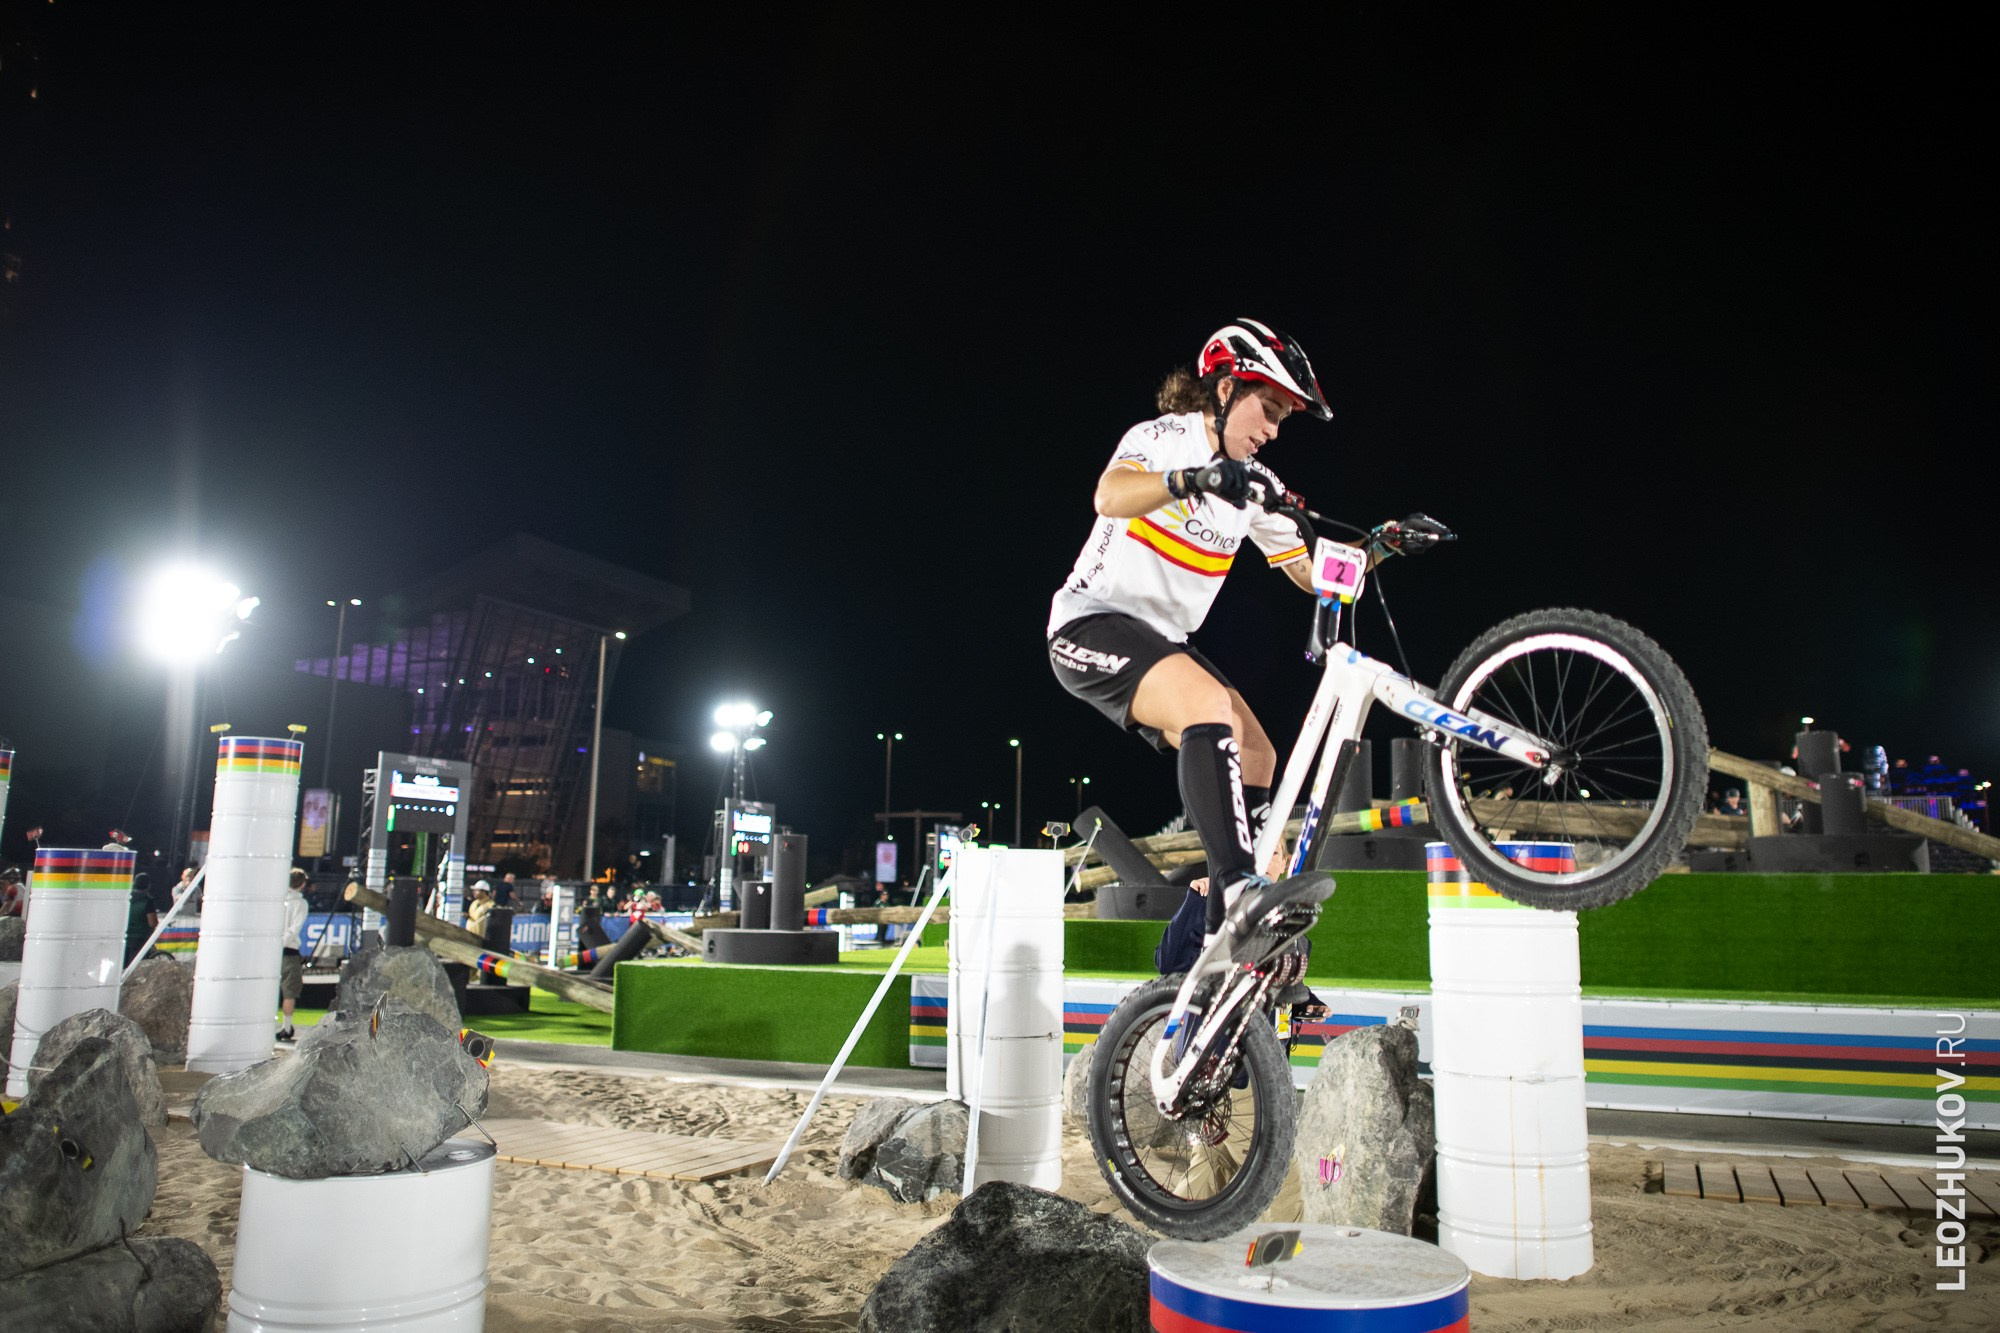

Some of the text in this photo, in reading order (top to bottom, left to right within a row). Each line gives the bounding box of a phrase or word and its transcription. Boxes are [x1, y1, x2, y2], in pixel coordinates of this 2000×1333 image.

[1335, 561, 1346, 584] 2
[1052, 640, 1131, 672] CLEAN
[1404, 700, 1511, 751] CLEAN
[1227, 757, 1253, 854] CLEAN
